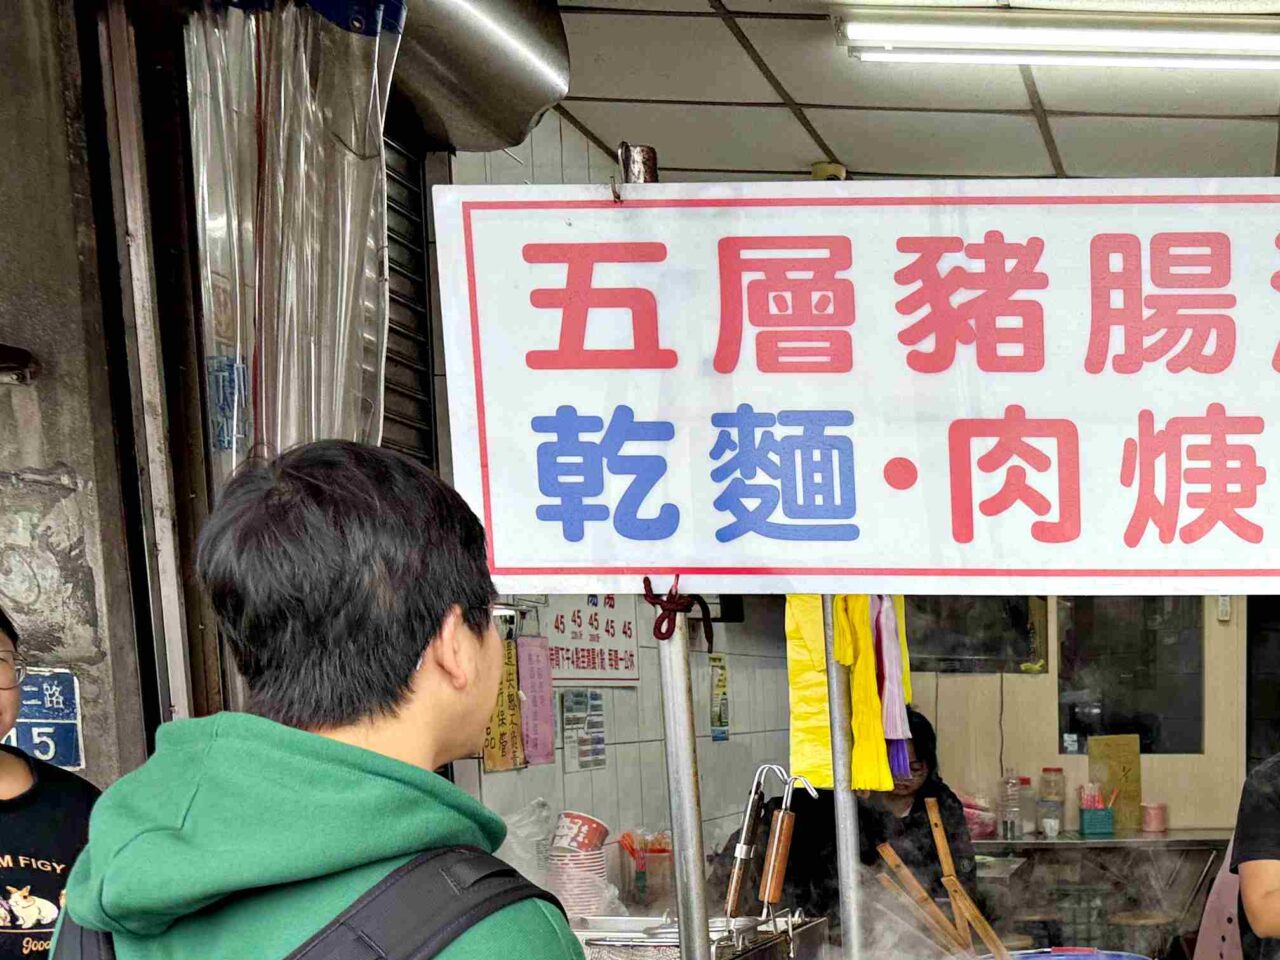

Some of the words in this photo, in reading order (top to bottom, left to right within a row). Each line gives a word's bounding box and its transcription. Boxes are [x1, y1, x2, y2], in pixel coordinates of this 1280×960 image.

[554, 614, 566, 635] 45
[570, 609, 583, 628] 45
[587, 612, 600, 631] 45
[604, 618, 616, 638] 45
[622, 621, 633, 639] 45
[18, 856, 67, 874] FIGY
